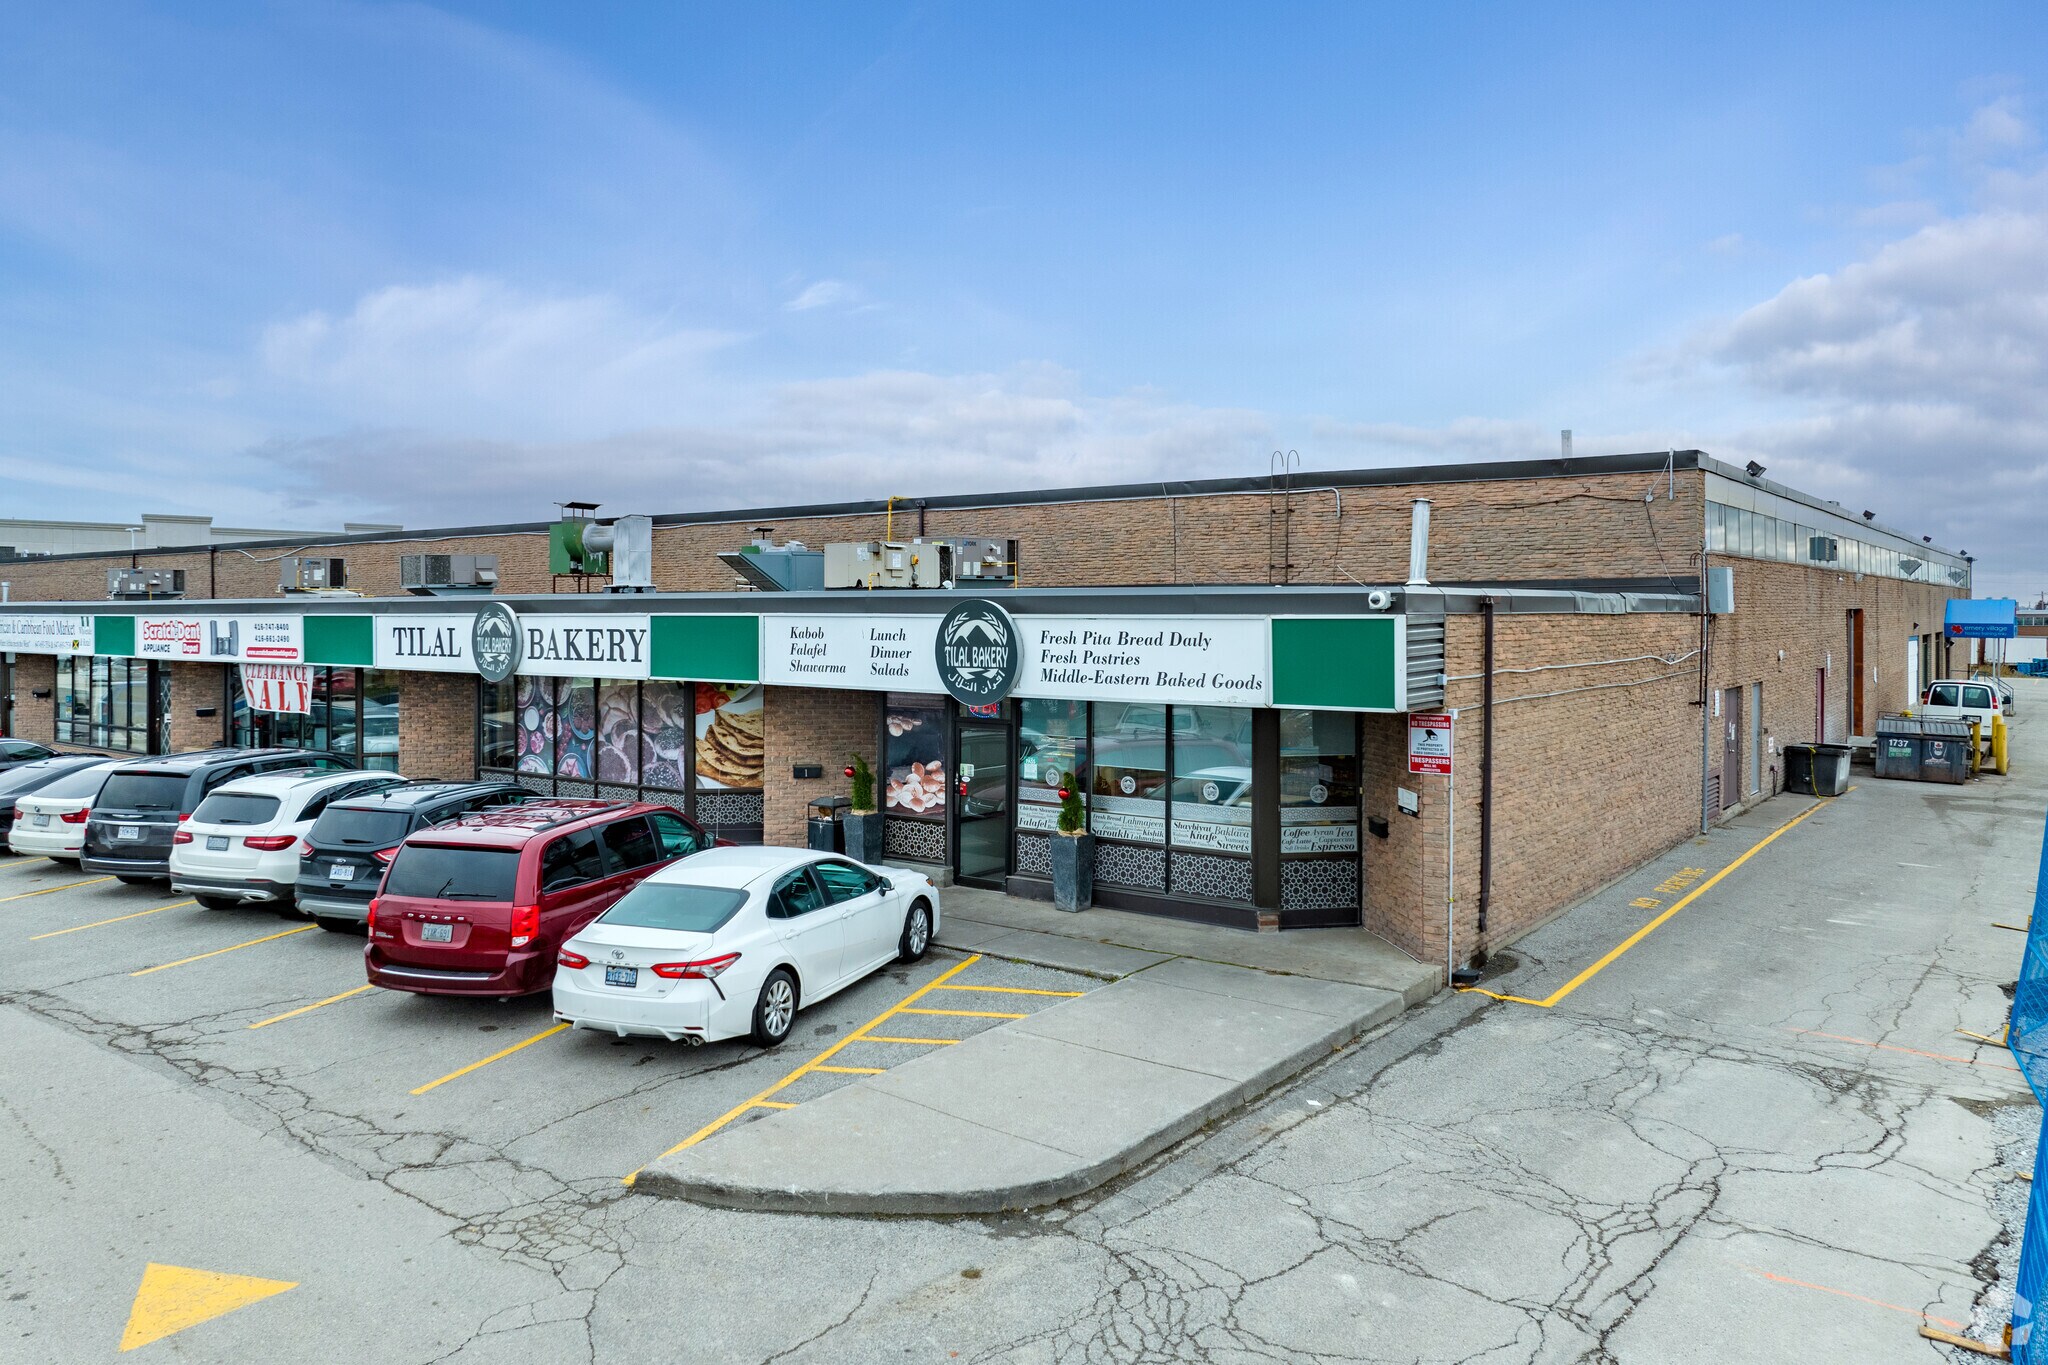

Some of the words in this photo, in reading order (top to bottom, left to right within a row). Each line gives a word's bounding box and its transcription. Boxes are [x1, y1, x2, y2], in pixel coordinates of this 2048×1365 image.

[43, 620, 54, 635] Food
[143, 620, 174, 640] Scratch
[177, 621, 201, 641] Dent
[790, 627, 824, 639] Kabob
[870, 628, 907, 641] Lunch
[392, 627, 462, 658] TILAL
[477, 636, 491, 653] TILAL
[491, 637, 512, 653] BAKERY
[527, 628, 647, 663] BAKERY
[1040, 630, 1077, 645] Fresh
[1082, 631, 1111, 645] Pita
[1117, 631, 1163, 647] Bread
[1169, 632, 1212, 651] Daily
[143, 644, 171, 653] APPLIANCE
[183, 643, 199, 654] Depot
[790, 643, 827, 659] Falafel
[870, 645, 912, 659] Dinner
[944, 646, 970, 667] TILAL
[972, 646, 1009, 668] BAKERY
[1040, 649, 1077, 664] Fresh
[1082, 650, 1140, 666] Pastries
[245, 664, 308, 681] CLEARANCE
[789, 659, 847, 674] Shawarma
[870, 662, 910, 677] Salads
[1040, 668, 1150, 686] Middle-Eastern
[1155, 671, 1206, 688] Baked
[1212, 673, 1262, 690] Goods
[245, 679, 309, 716] SALE
[1888, 739, 1909, 748] 1737
[1019, 817, 1048, 829] Falafel
[1122, 816, 1164, 830] Lahmajeen
[1091, 827, 1129, 839] Saroukh
[1142, 829, 1164, 838] Kishik
[1190, 830, 1217, 843] Knafe
[1215, 826, 1249, 838] Baklava
[1283, 828, 1310, 839] Coffee
[1335, 827, 1354, 837] Tea
[1216, 840, 1249, 851] Sweets
[1311, 842, 1355, 852] Espresso
